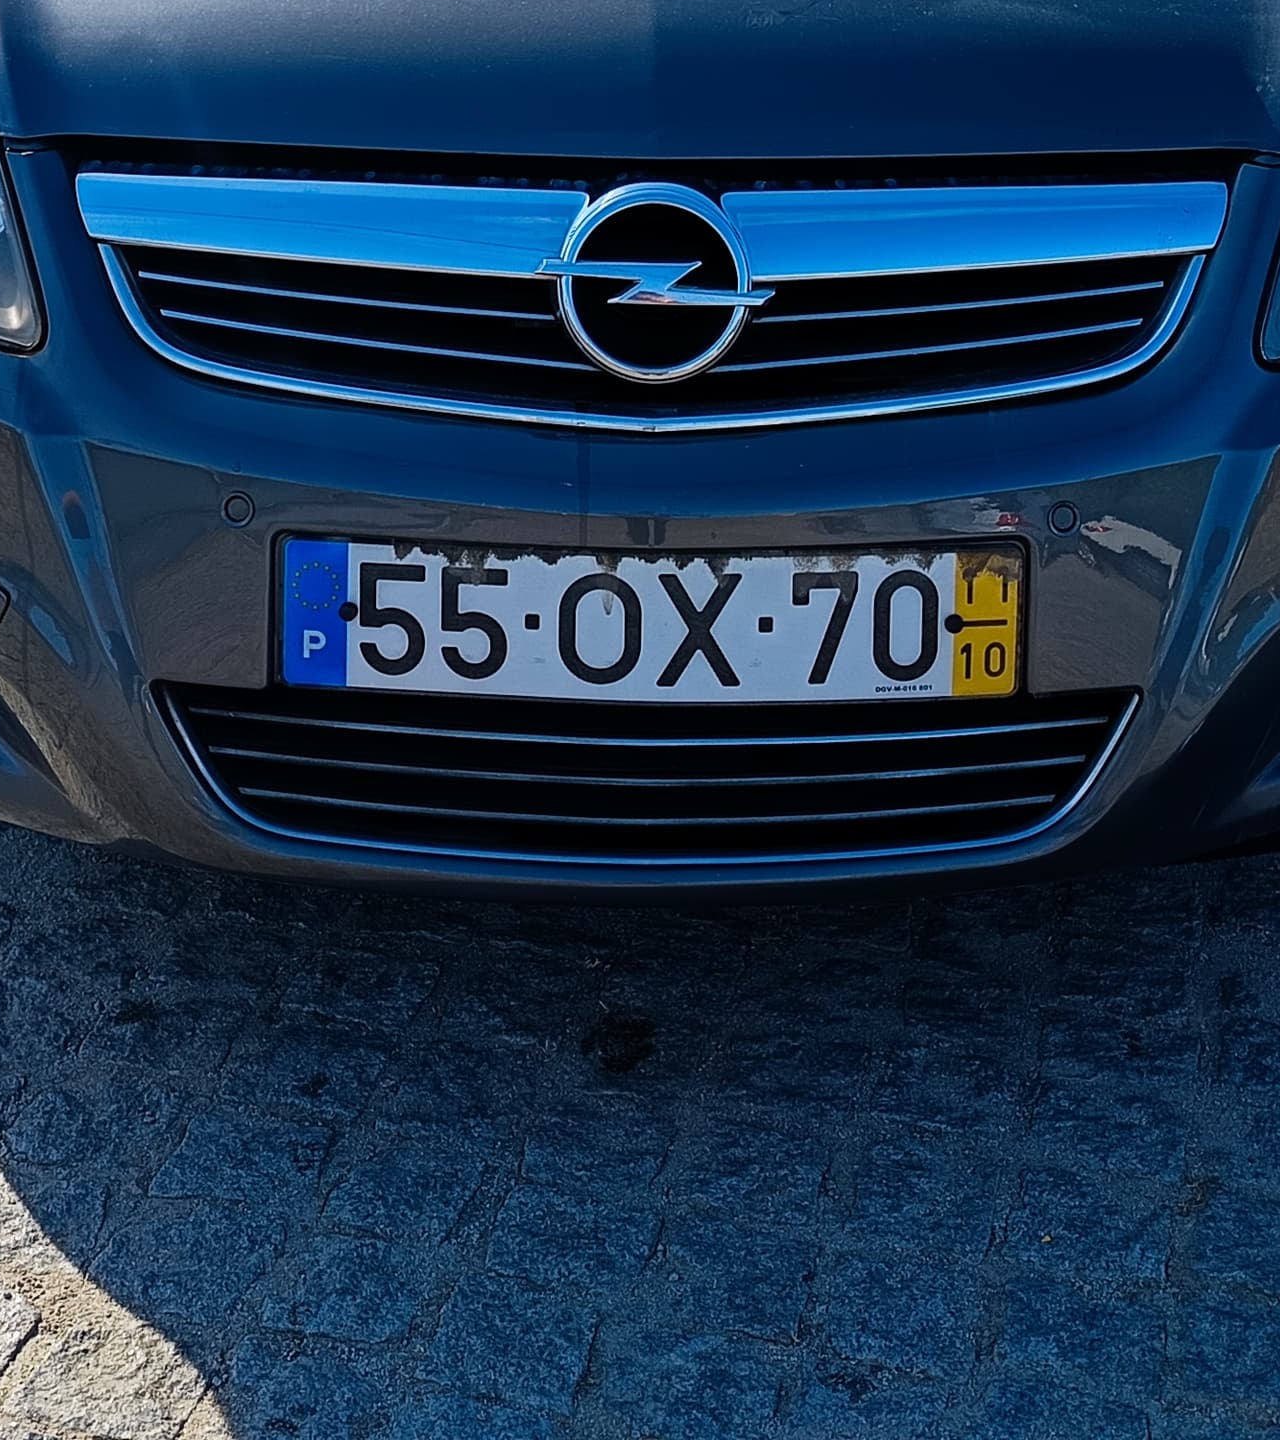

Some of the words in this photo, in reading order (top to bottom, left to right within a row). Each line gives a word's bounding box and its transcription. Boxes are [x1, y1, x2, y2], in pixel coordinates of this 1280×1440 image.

[359, 562, 939, 686] 55·OX·70
[303, 629, 326, 658] P
[960, 641, 1006, 679] 10
